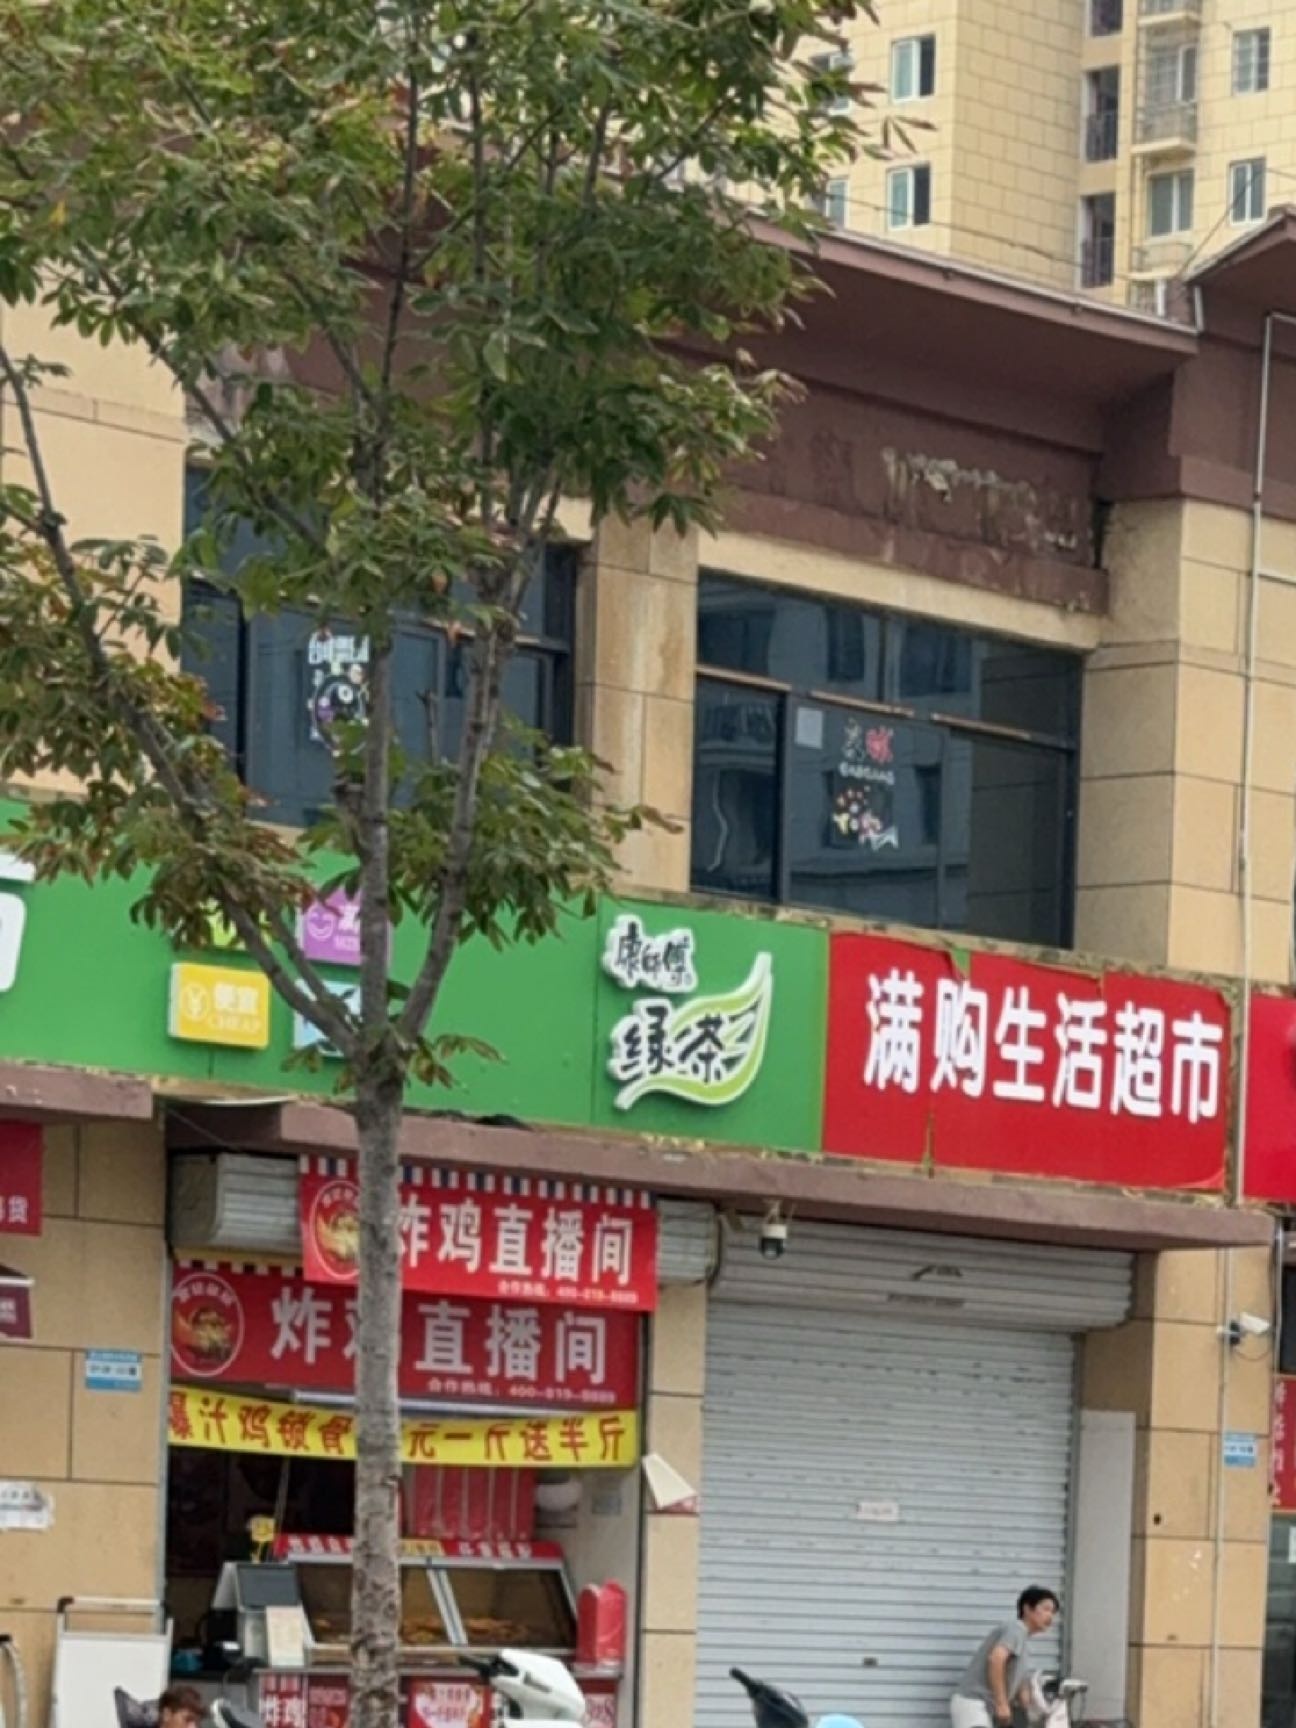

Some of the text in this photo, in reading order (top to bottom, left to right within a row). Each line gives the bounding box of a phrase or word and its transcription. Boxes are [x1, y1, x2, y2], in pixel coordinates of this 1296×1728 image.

[612, 920, 695, 988] 康师傅
[616, 1003, 726, 1086] 绿茶
[863, 968, 1223, 1124] 满购生活超市
[271, 1286, 606, 1385] 炸直播间
